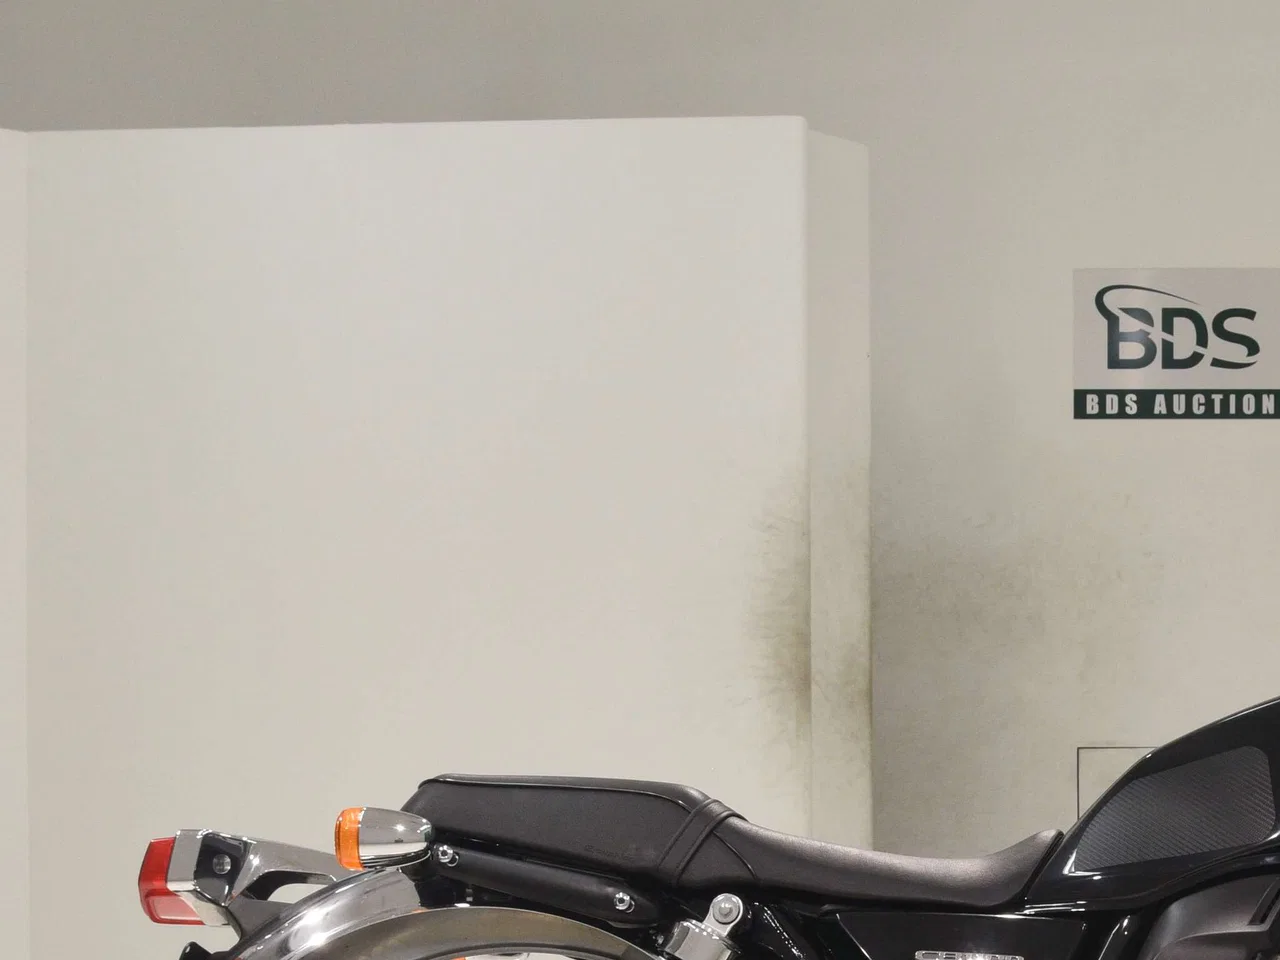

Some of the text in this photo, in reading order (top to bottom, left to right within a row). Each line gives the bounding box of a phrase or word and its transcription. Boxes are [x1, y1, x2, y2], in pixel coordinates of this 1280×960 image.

[1095, 284, 1261, 370] BDS
[1086, 393, 1275, 415] BDS AUCTION
